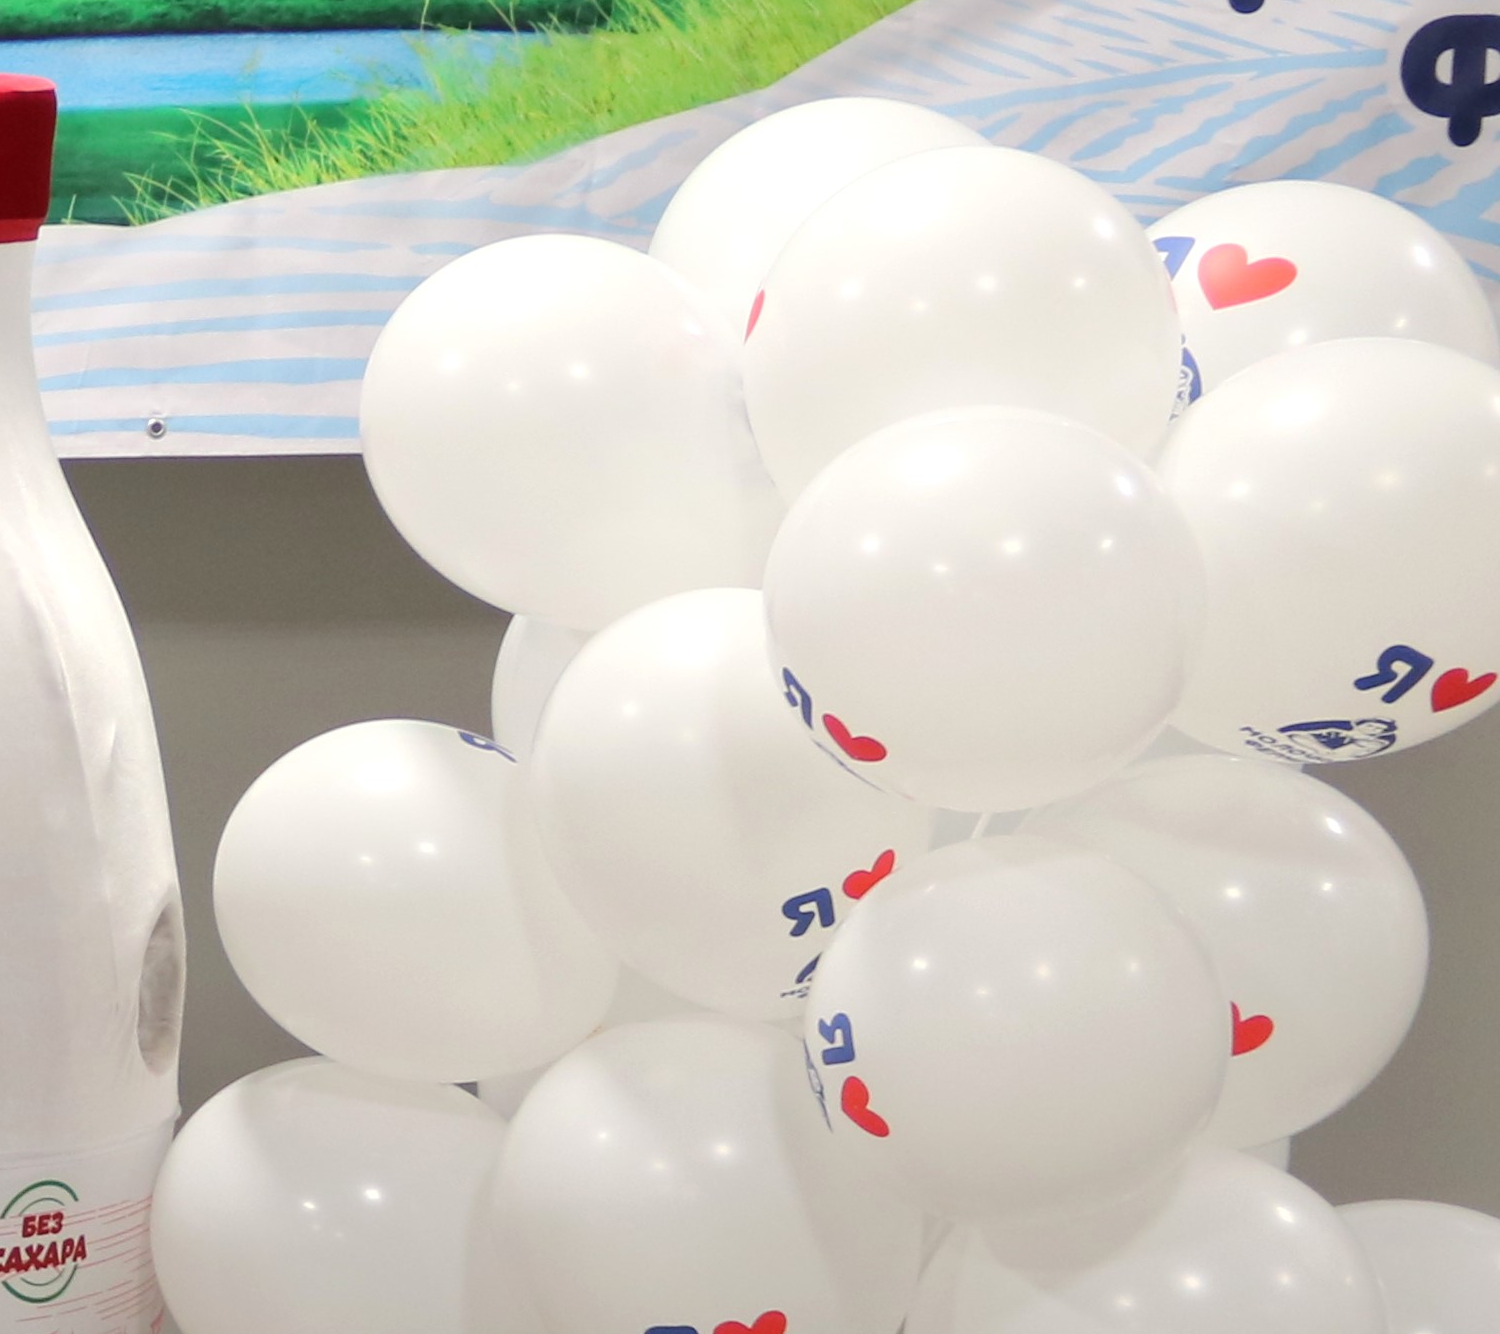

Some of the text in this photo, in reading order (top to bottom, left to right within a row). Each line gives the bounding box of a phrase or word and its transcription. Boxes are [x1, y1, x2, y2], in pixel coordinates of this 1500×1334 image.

[1353, 643, 1435, 704] Я
[781, 886, 836, 937] Я
[818, 1011, 855, 1065] Я
[20, 1211, 65, 1239] БЕЗ
